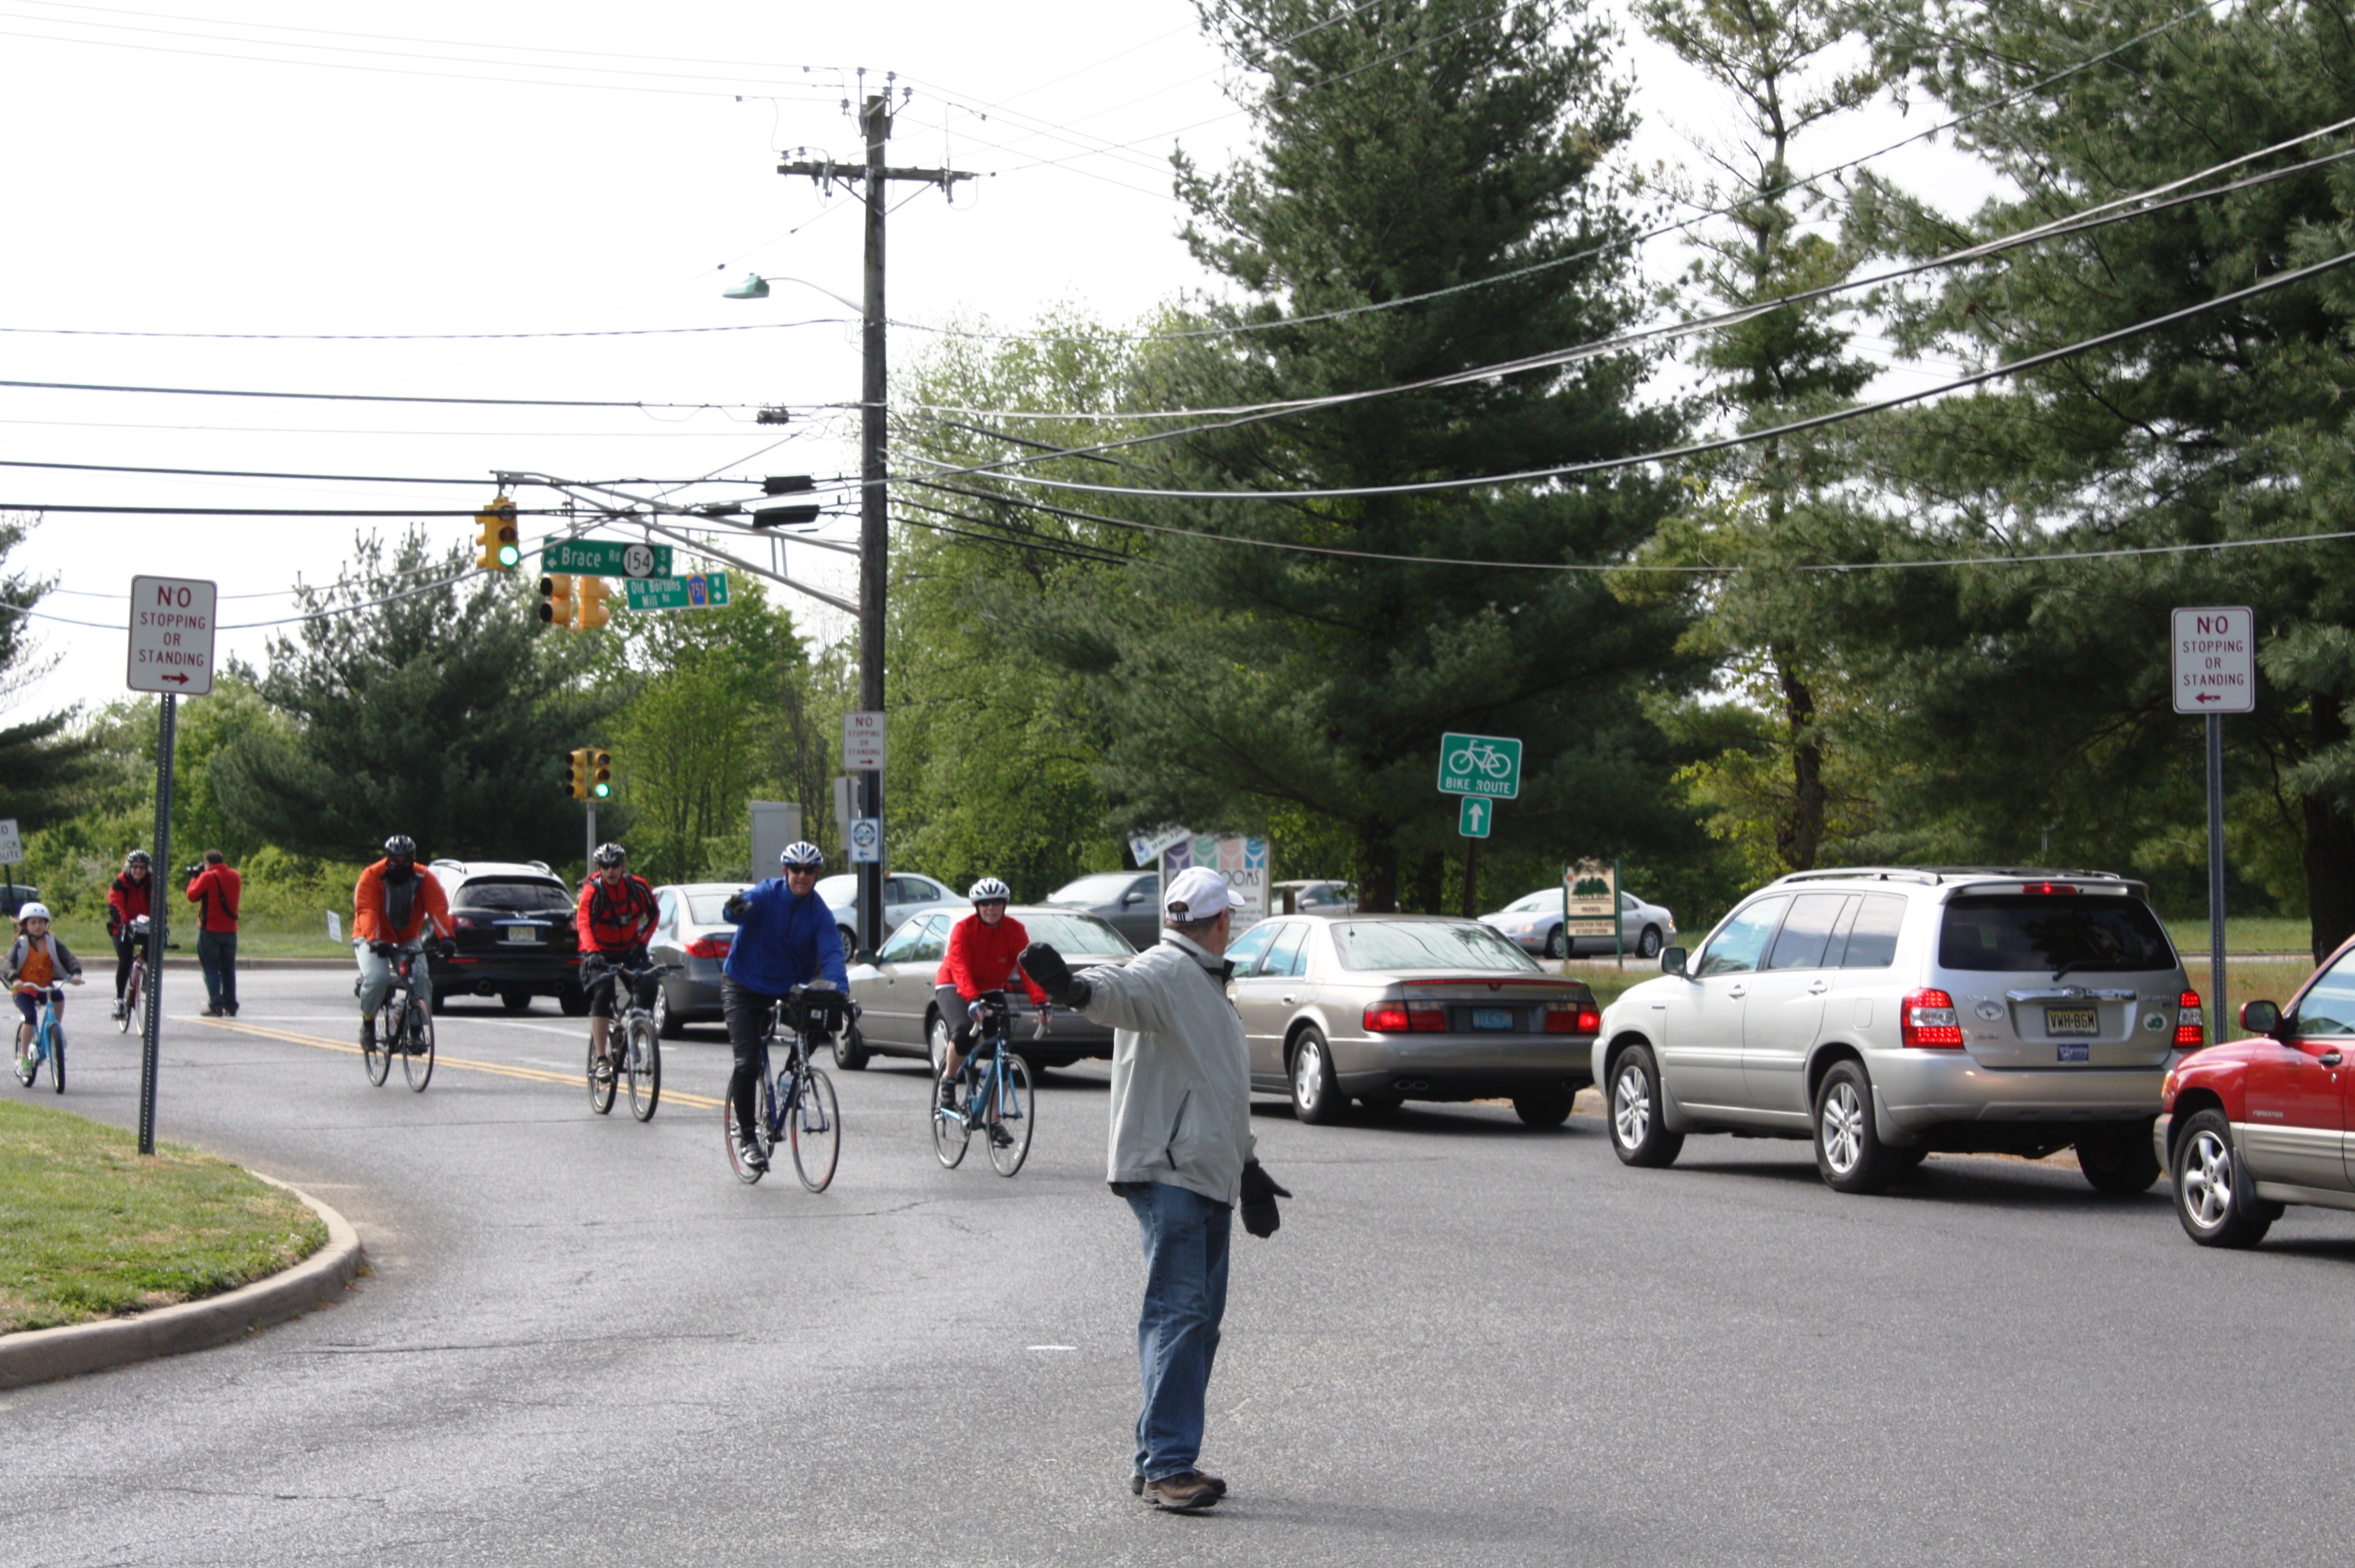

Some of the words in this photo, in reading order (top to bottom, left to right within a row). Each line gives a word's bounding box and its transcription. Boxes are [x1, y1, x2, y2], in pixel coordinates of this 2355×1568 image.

[562, 547, 602, 567] Brace
[609, 550, 621, 563] Rd
[627, 551, 651, 570] 154
[660, 549, 667, 561] S
[631, 580, 645, 594] Old
[649, 580, 681, 593] Bortons
[690, 583, 705, 598] 757
[714, 577, 720, 587] W
[157, 585, 191, 608] NO
[642, 594, 658, 608] Mill
[662, 593, 670, 602] Rd
[140, 612, 206, 630] STOPPING
[2197, 615, 2228, 635] NO
[163, 632, 182, 646] OR
[2183, 640, 2244, 654] STOPPING
[139, 650, 204, 667] STANDING
[2206, 657, 2222, 669] OR
[2183, 673, 2244, 686] STANDING
[856, 717, 873, 727] NO
[1445, 776, 1470, 790] BIKE
[1476, 779, 1511, 794] ROUTE
[0, 840, 18, 850] UCK
[1220, 869, 1260, 885] OOMS
